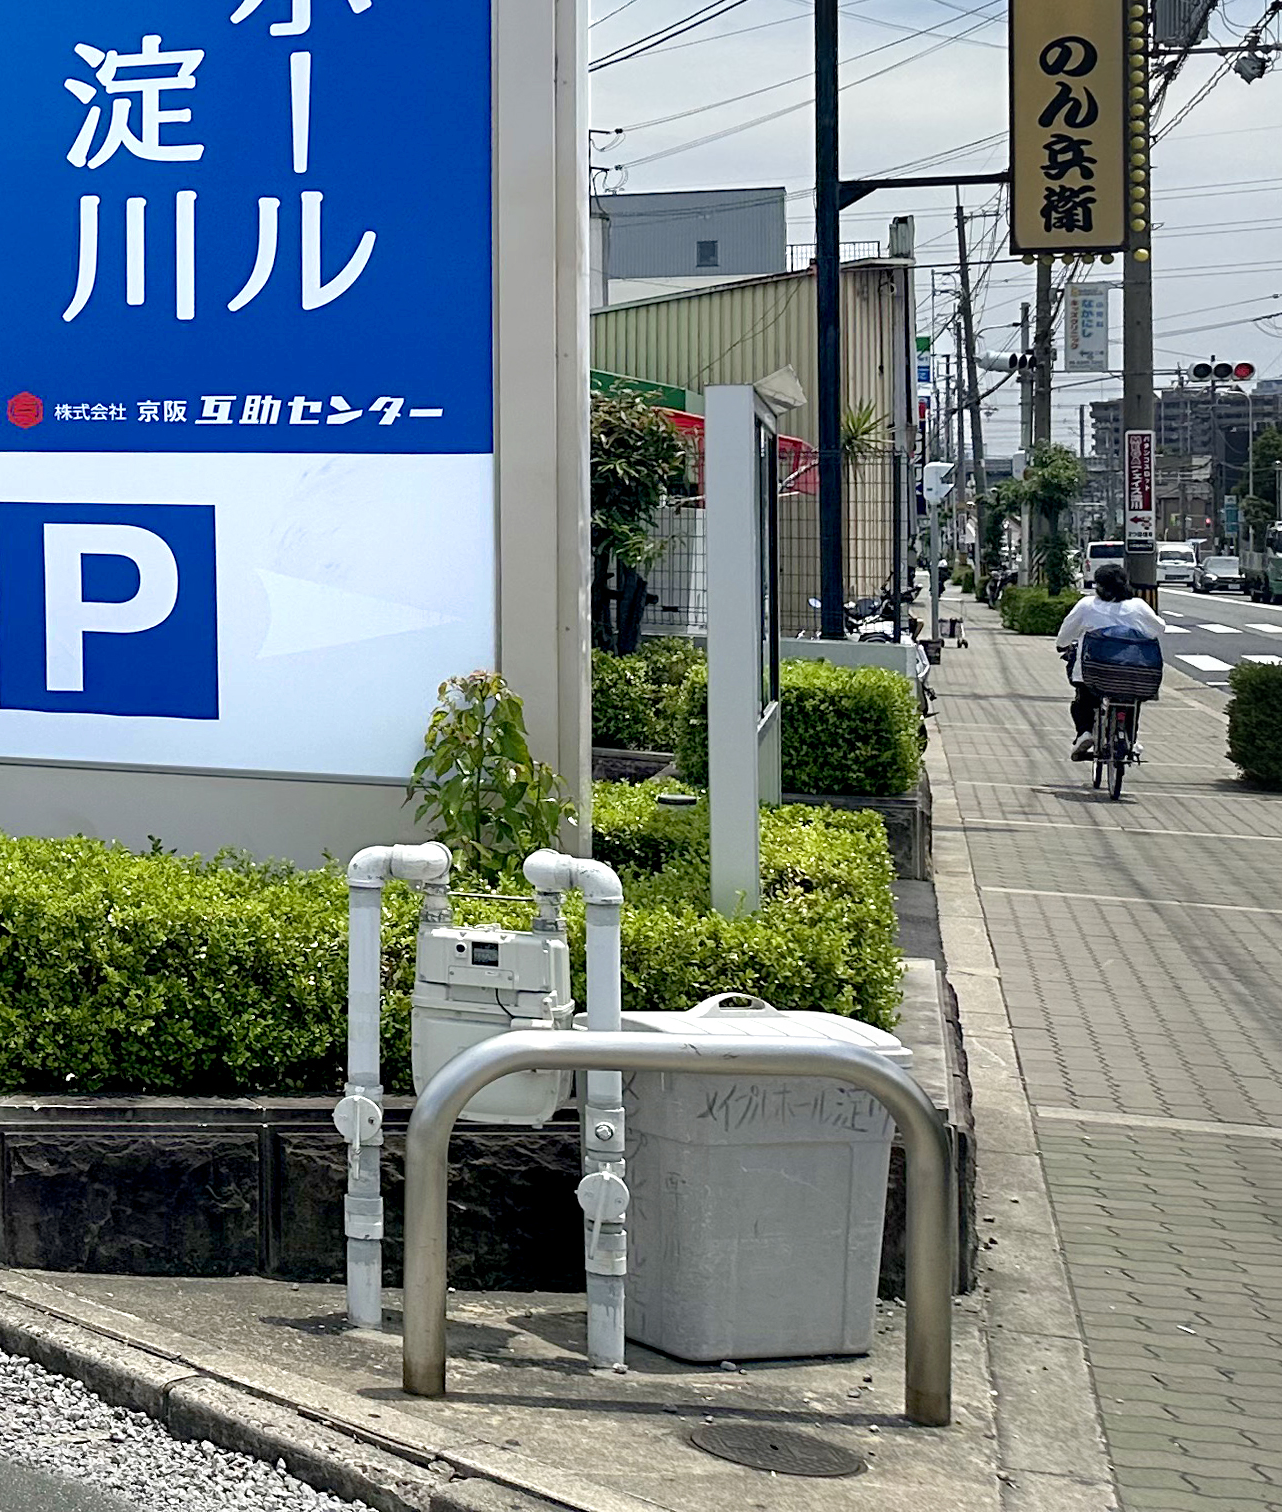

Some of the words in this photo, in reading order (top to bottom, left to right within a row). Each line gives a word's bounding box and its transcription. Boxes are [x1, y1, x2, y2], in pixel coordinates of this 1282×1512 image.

[63, 34, 205, 323] 淀川
[1038, 35, 1099, 233] のん兵衛
[1081, 299, 1094, 338] なかにし
[54, 402, 127, 422] 株式会社
[137, 399, 188, 423] 京阪
[194, 394, 445, 426] 互助センター
[43, 522, 180, 693] P
